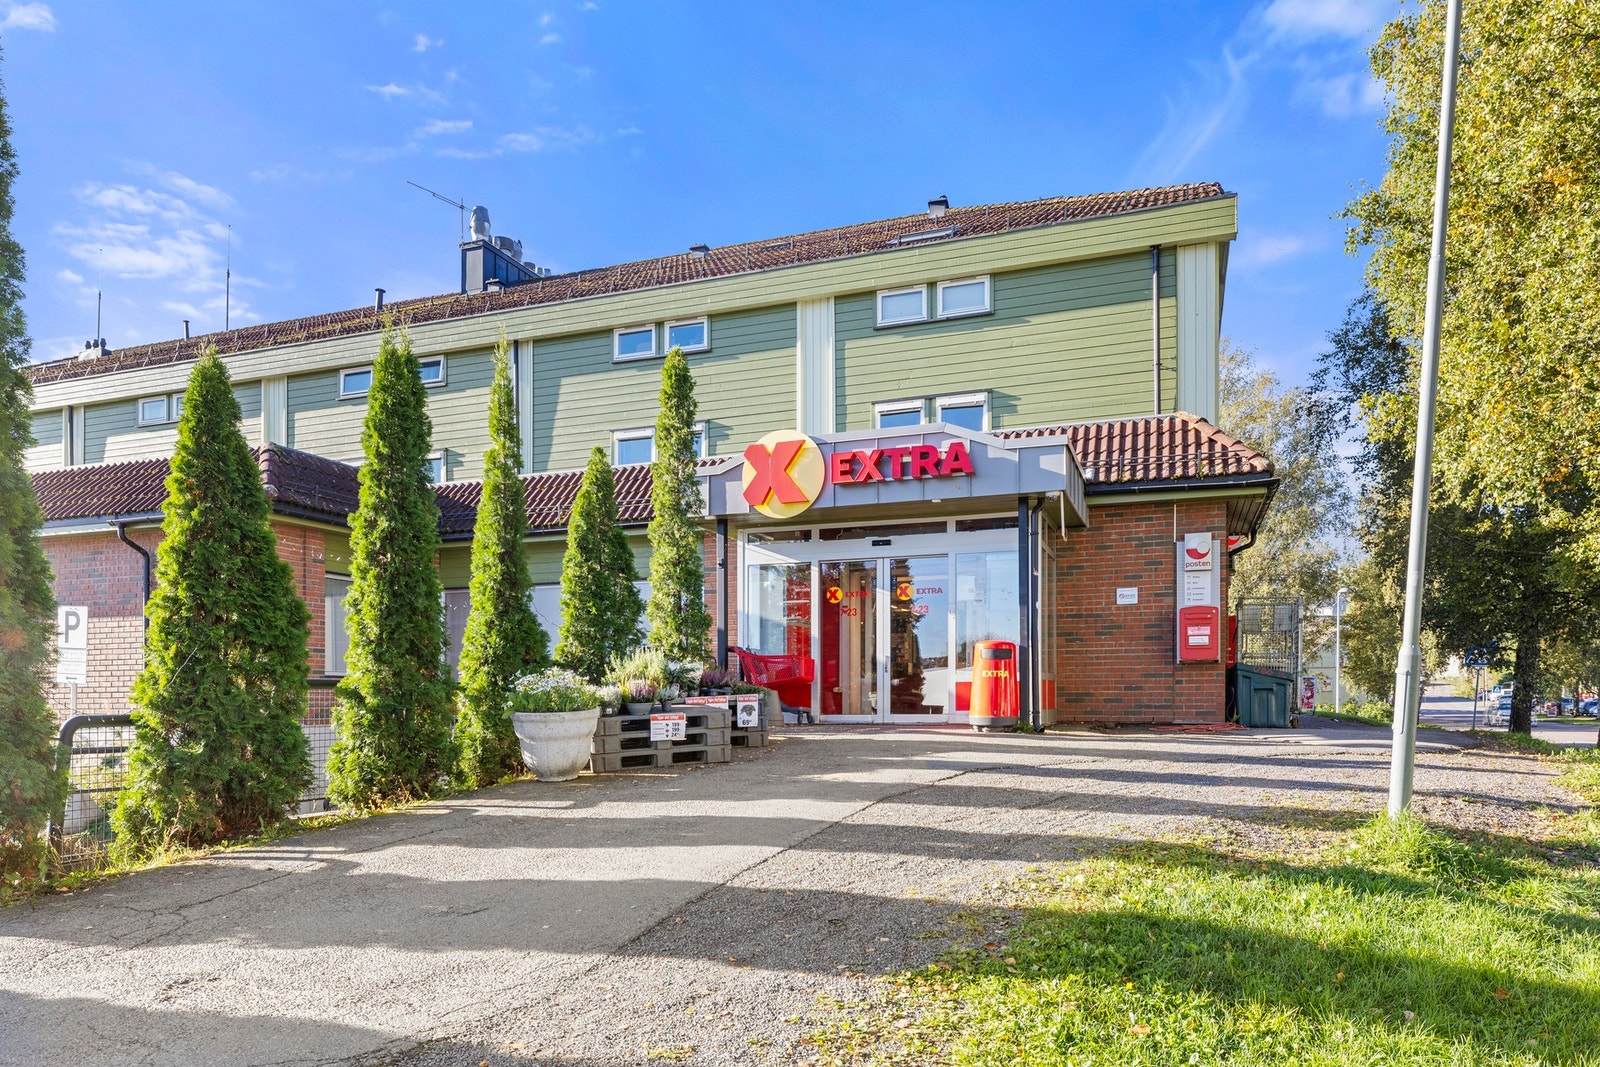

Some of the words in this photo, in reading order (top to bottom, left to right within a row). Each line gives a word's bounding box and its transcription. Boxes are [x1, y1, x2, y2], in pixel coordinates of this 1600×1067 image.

[743, 440, 809, 506] X
[831, 441, 975, 484] EXTRA
[1185, 560, 1211, 569] posten
[845, 590, 871, 598] EXTRA
[916, 587, 943, 595] EXTRA
[65, 611, 80, 643] P
[981, 669, 1010, 678] EXTRA
